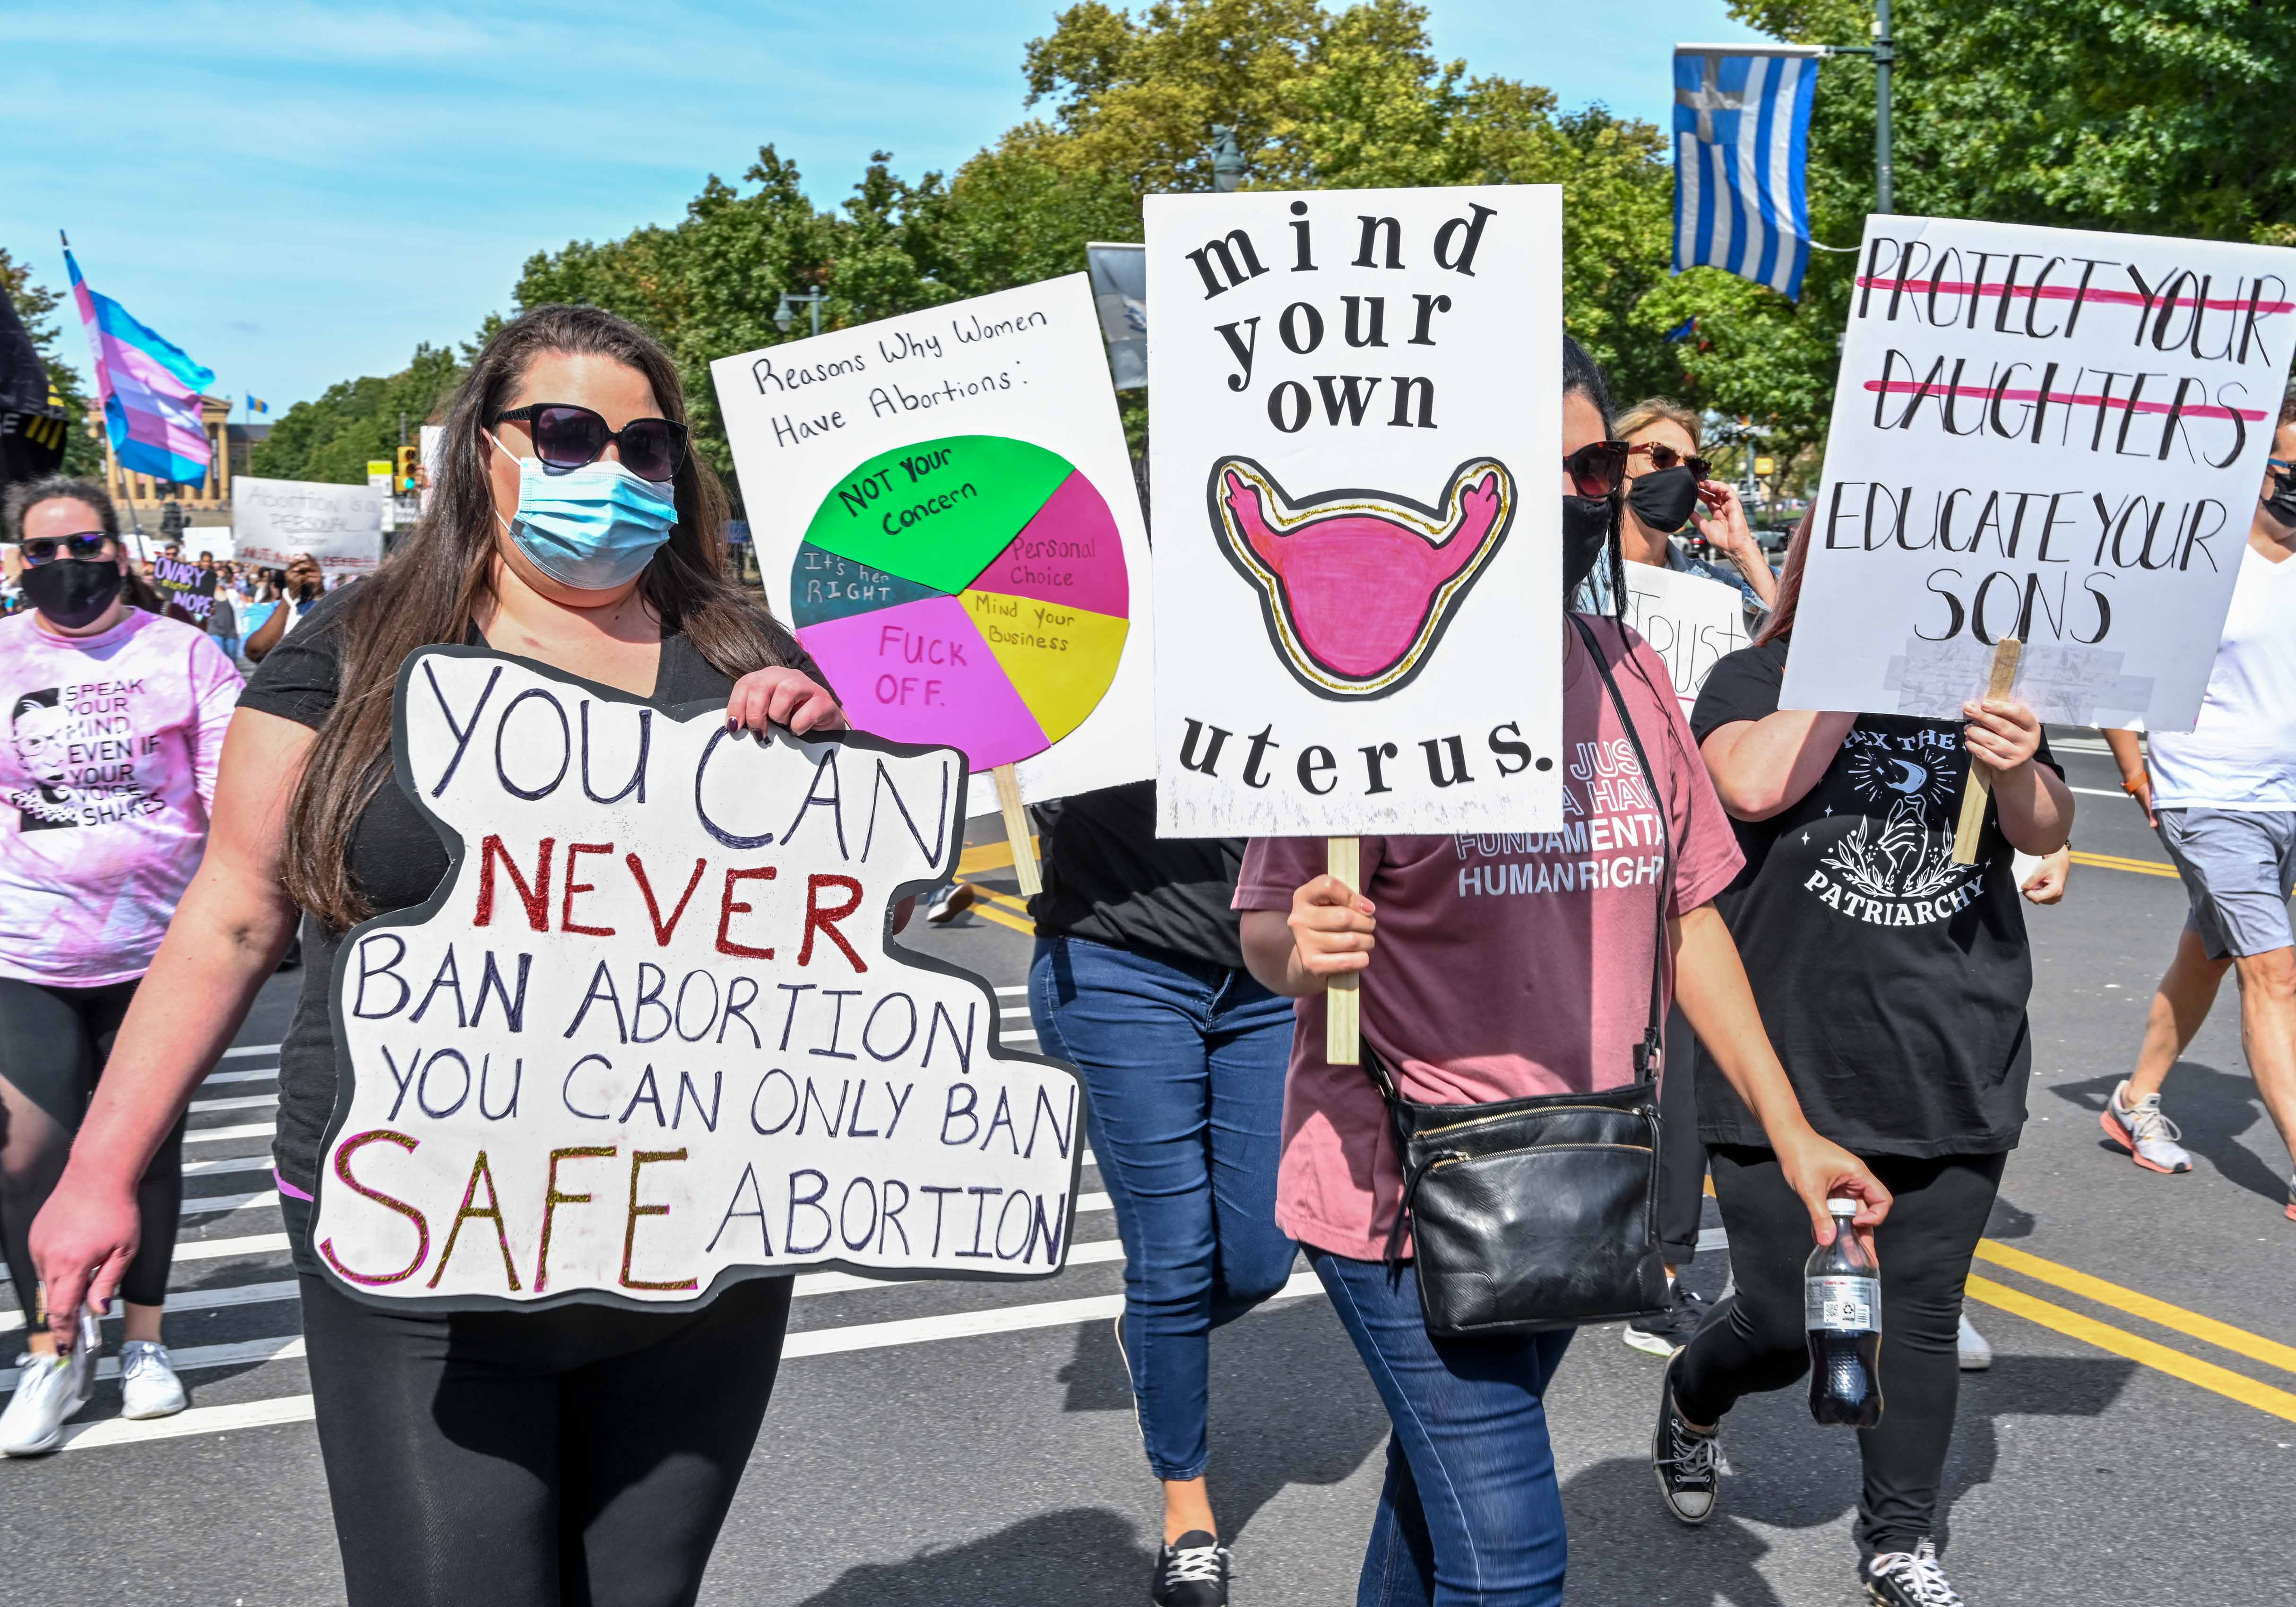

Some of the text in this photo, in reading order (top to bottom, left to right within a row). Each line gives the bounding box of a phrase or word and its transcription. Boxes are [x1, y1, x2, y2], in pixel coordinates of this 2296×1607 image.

[1185, 201, 1497, 301] mind
[1858, 238, 2286, 367] PROTECT YOUR
[752, 312, 1046, 395] Reasons Why Women
[1214, 294, 1451, 392] your
[772, 360, 1028, 447] Have Abortions:
[1268, 375, 1437, 433] own
[1874, 349, 2247, 468] DAUGHTERS
[838, 468, 893, 517] NOT
[882, 483, 977, 536] Concern
[1012, 536, 1095, 560] Personal
[1826, 482, 2227, 572] EDUCATE YOUR
[155, 557, 207, 588] OVARY
[804, 552, 889, 583] It's her
[1011, 566, 1073, 586] Choice
[173, 590, 213, 617] NOPE
[807, 579, 890, 604] RIGHT
[1914, 569, 2115, 645] SONS
[879, 624, 967, 666] FUCK
[988, 625, 1069, 652] Business
[64, 698, 129, 717] YOUR
[65, 679, 145, 701] SPEAK
[875, 673, 945, 707] OFF.
[66, 717, 130, 739] MIND
[68, 734, 160, 764] EVEN IF
[1897, 729, 1956, 752] THE
[69, 764, 137, 786] YOUR
[423, 659, 949, 868] YOU CAN
[1180, 717, 1553, 795] uterus.
[1570, 738, 1641, 780] JUS
[76, 782, 144, 803] VOICE
[82, 792, 166, 826] SHAKES
[1586, 777, 1659, 814] HAV
[1454, 814, 1666, 860] FUNDAMENTA
[1459, 856, 1664, 898] HUMAN RIGH
[1804, 870, 1984, 926] PATRIARCHY
[473, 834, 868, 973] NEVER
[353, 933, 975, 1074] BAN ABORTION
[382, 1045, 1075, 1159] YOU CAN ONLY BAN
[319, 1130, 1066, 1293] SAFE ABORTION
